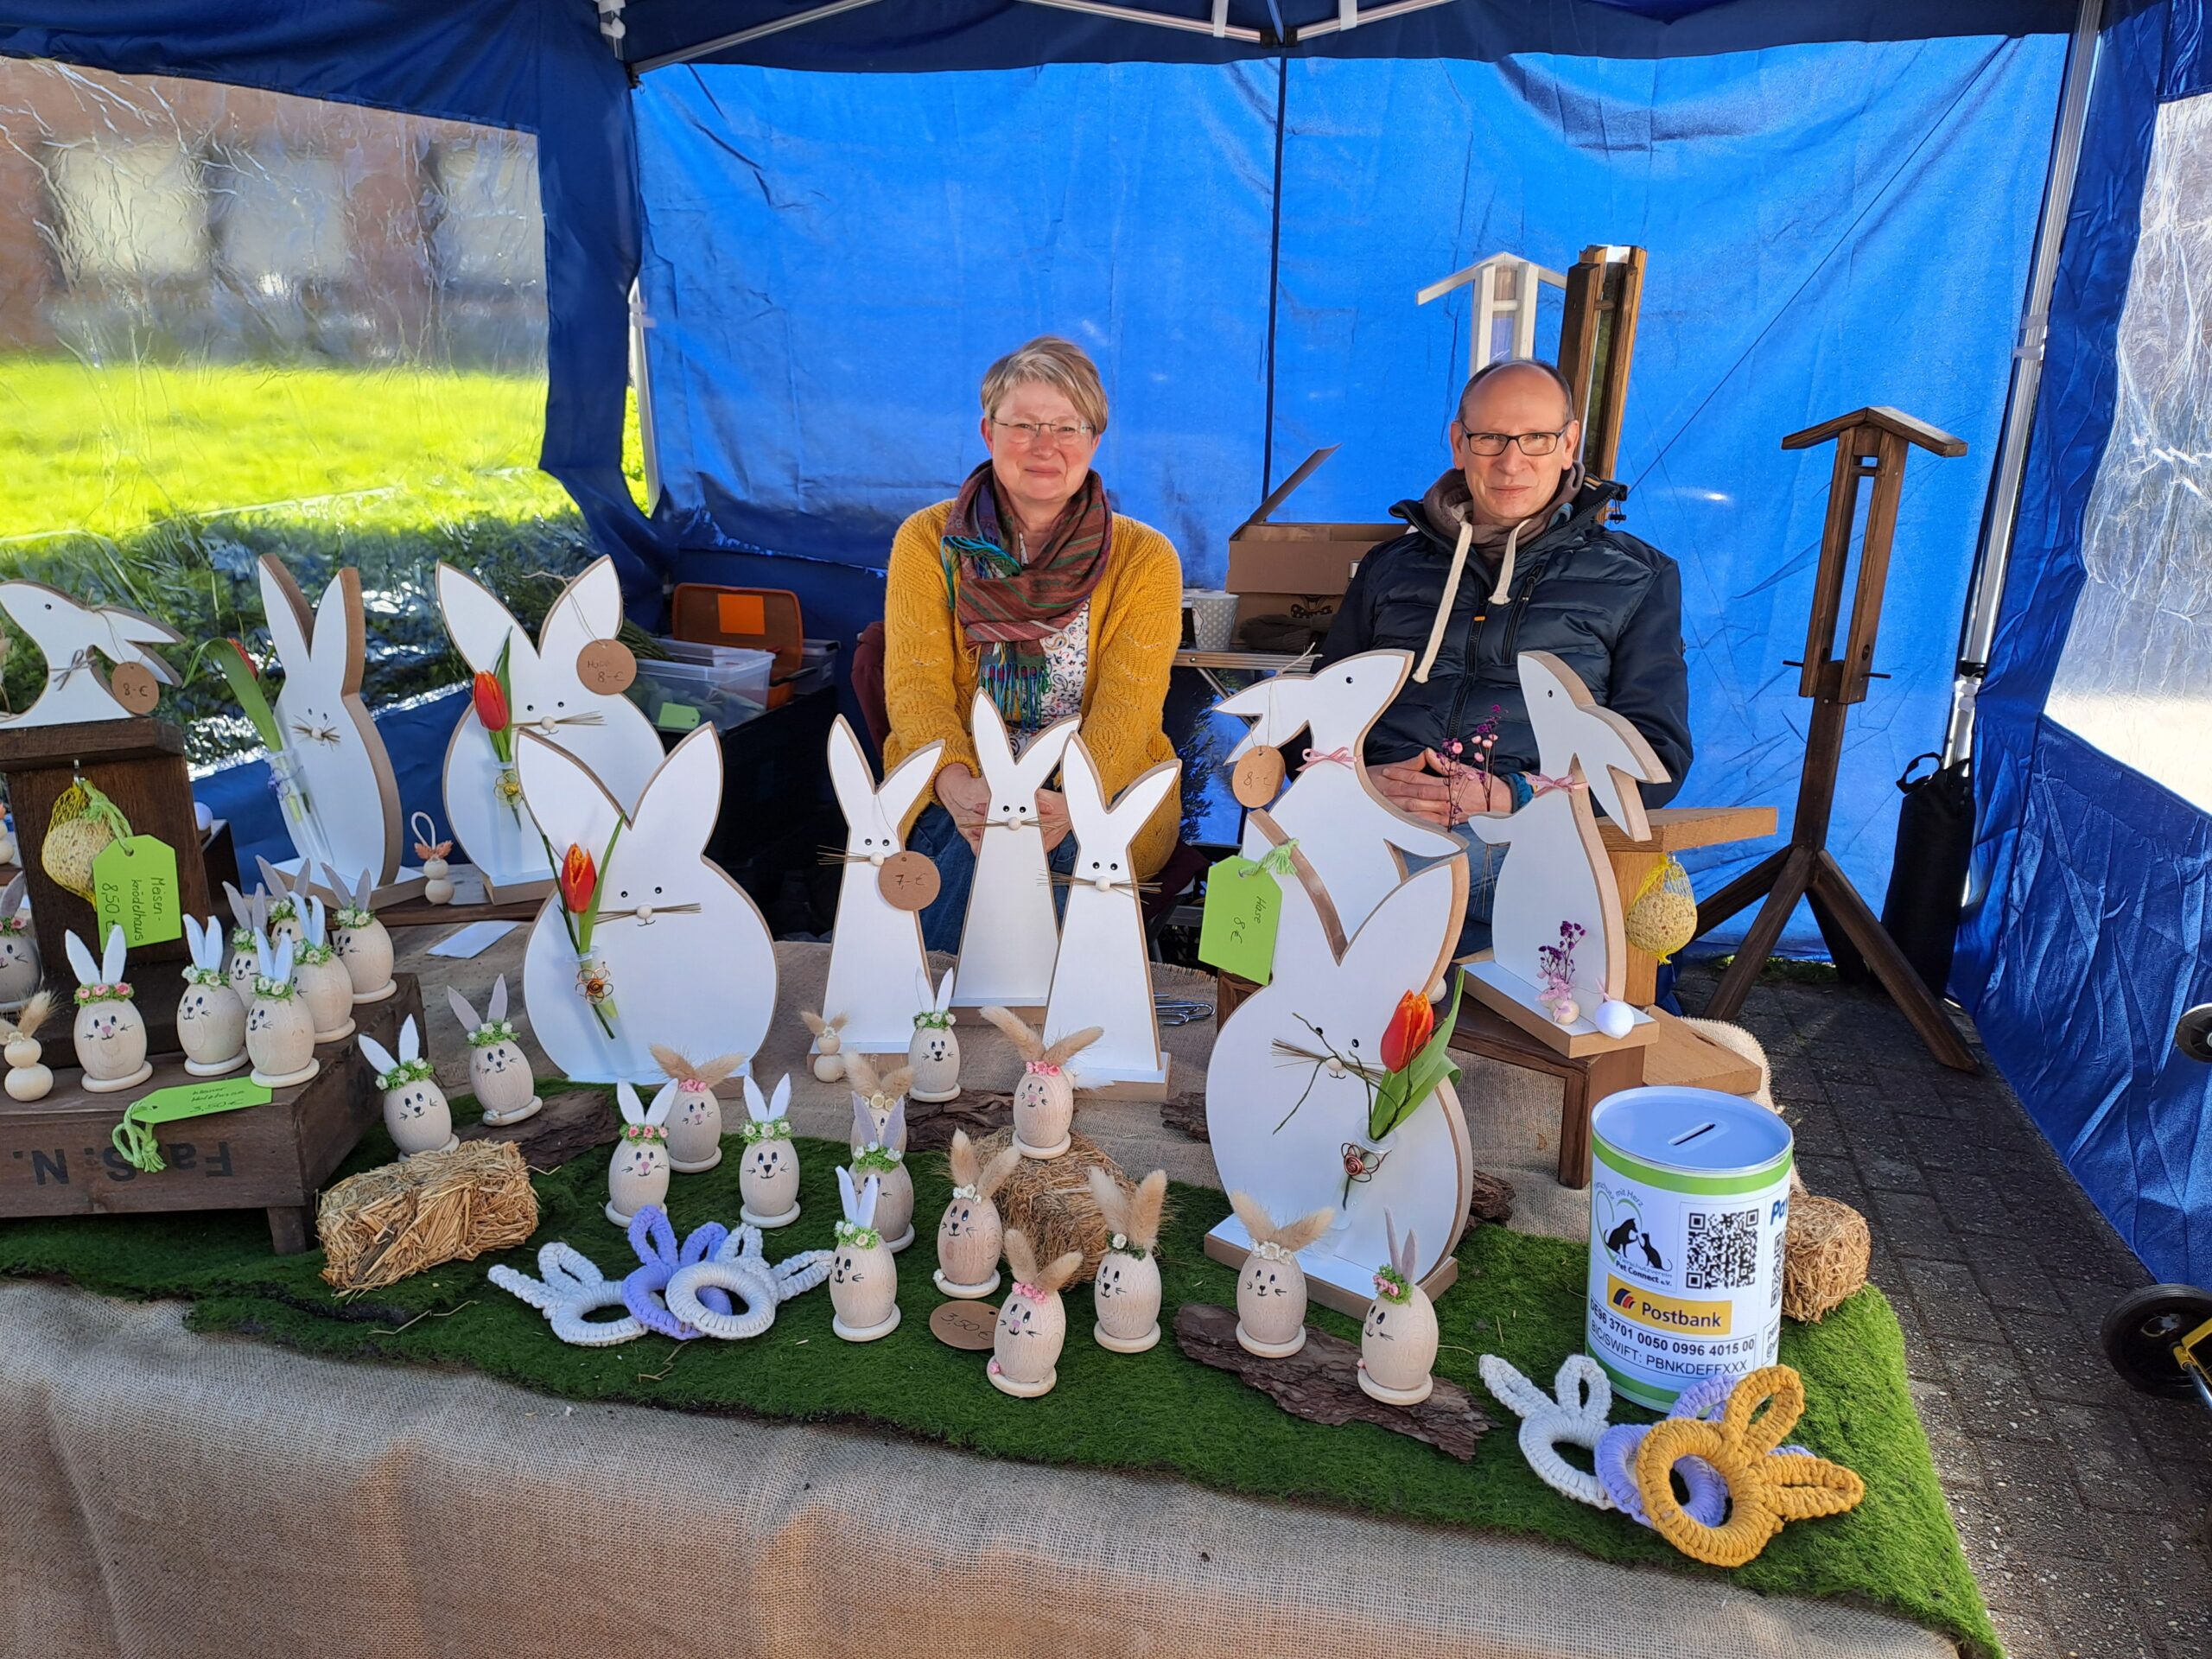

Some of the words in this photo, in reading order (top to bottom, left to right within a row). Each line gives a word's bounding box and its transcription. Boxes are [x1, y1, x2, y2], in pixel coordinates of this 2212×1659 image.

[101, 882, 120, 913] 8,50
[1254, 896, 1267, 924] Hase
[1616, 1187, 1626, 1197] mit
[1627, 1189, 1643, 1207] Herz
[1616, 1261, 1627, 1272] Pet
[1628, 1267, 1660, 1283] Connect
[1661, 1278, 1673, 1287] e.V.
[1590, 1298, 1607, 1325] DE96
[1609, 1318, 1633, 1339] 3701
[1637, 1332, 1669, 1351] 0050
[1672, 1342, 1705, 1356] 0996
[1709, 1342, 1739, 1356] 4015
[1742, 1338, 1755, 1352] 00
[1642, 1301, 1721, 1327] Postbank
[1591, 1319, 1643, 1363] BIC/SWIFT:
[1646, 1354, 1747, 1376] PBNKDEFFXXX
